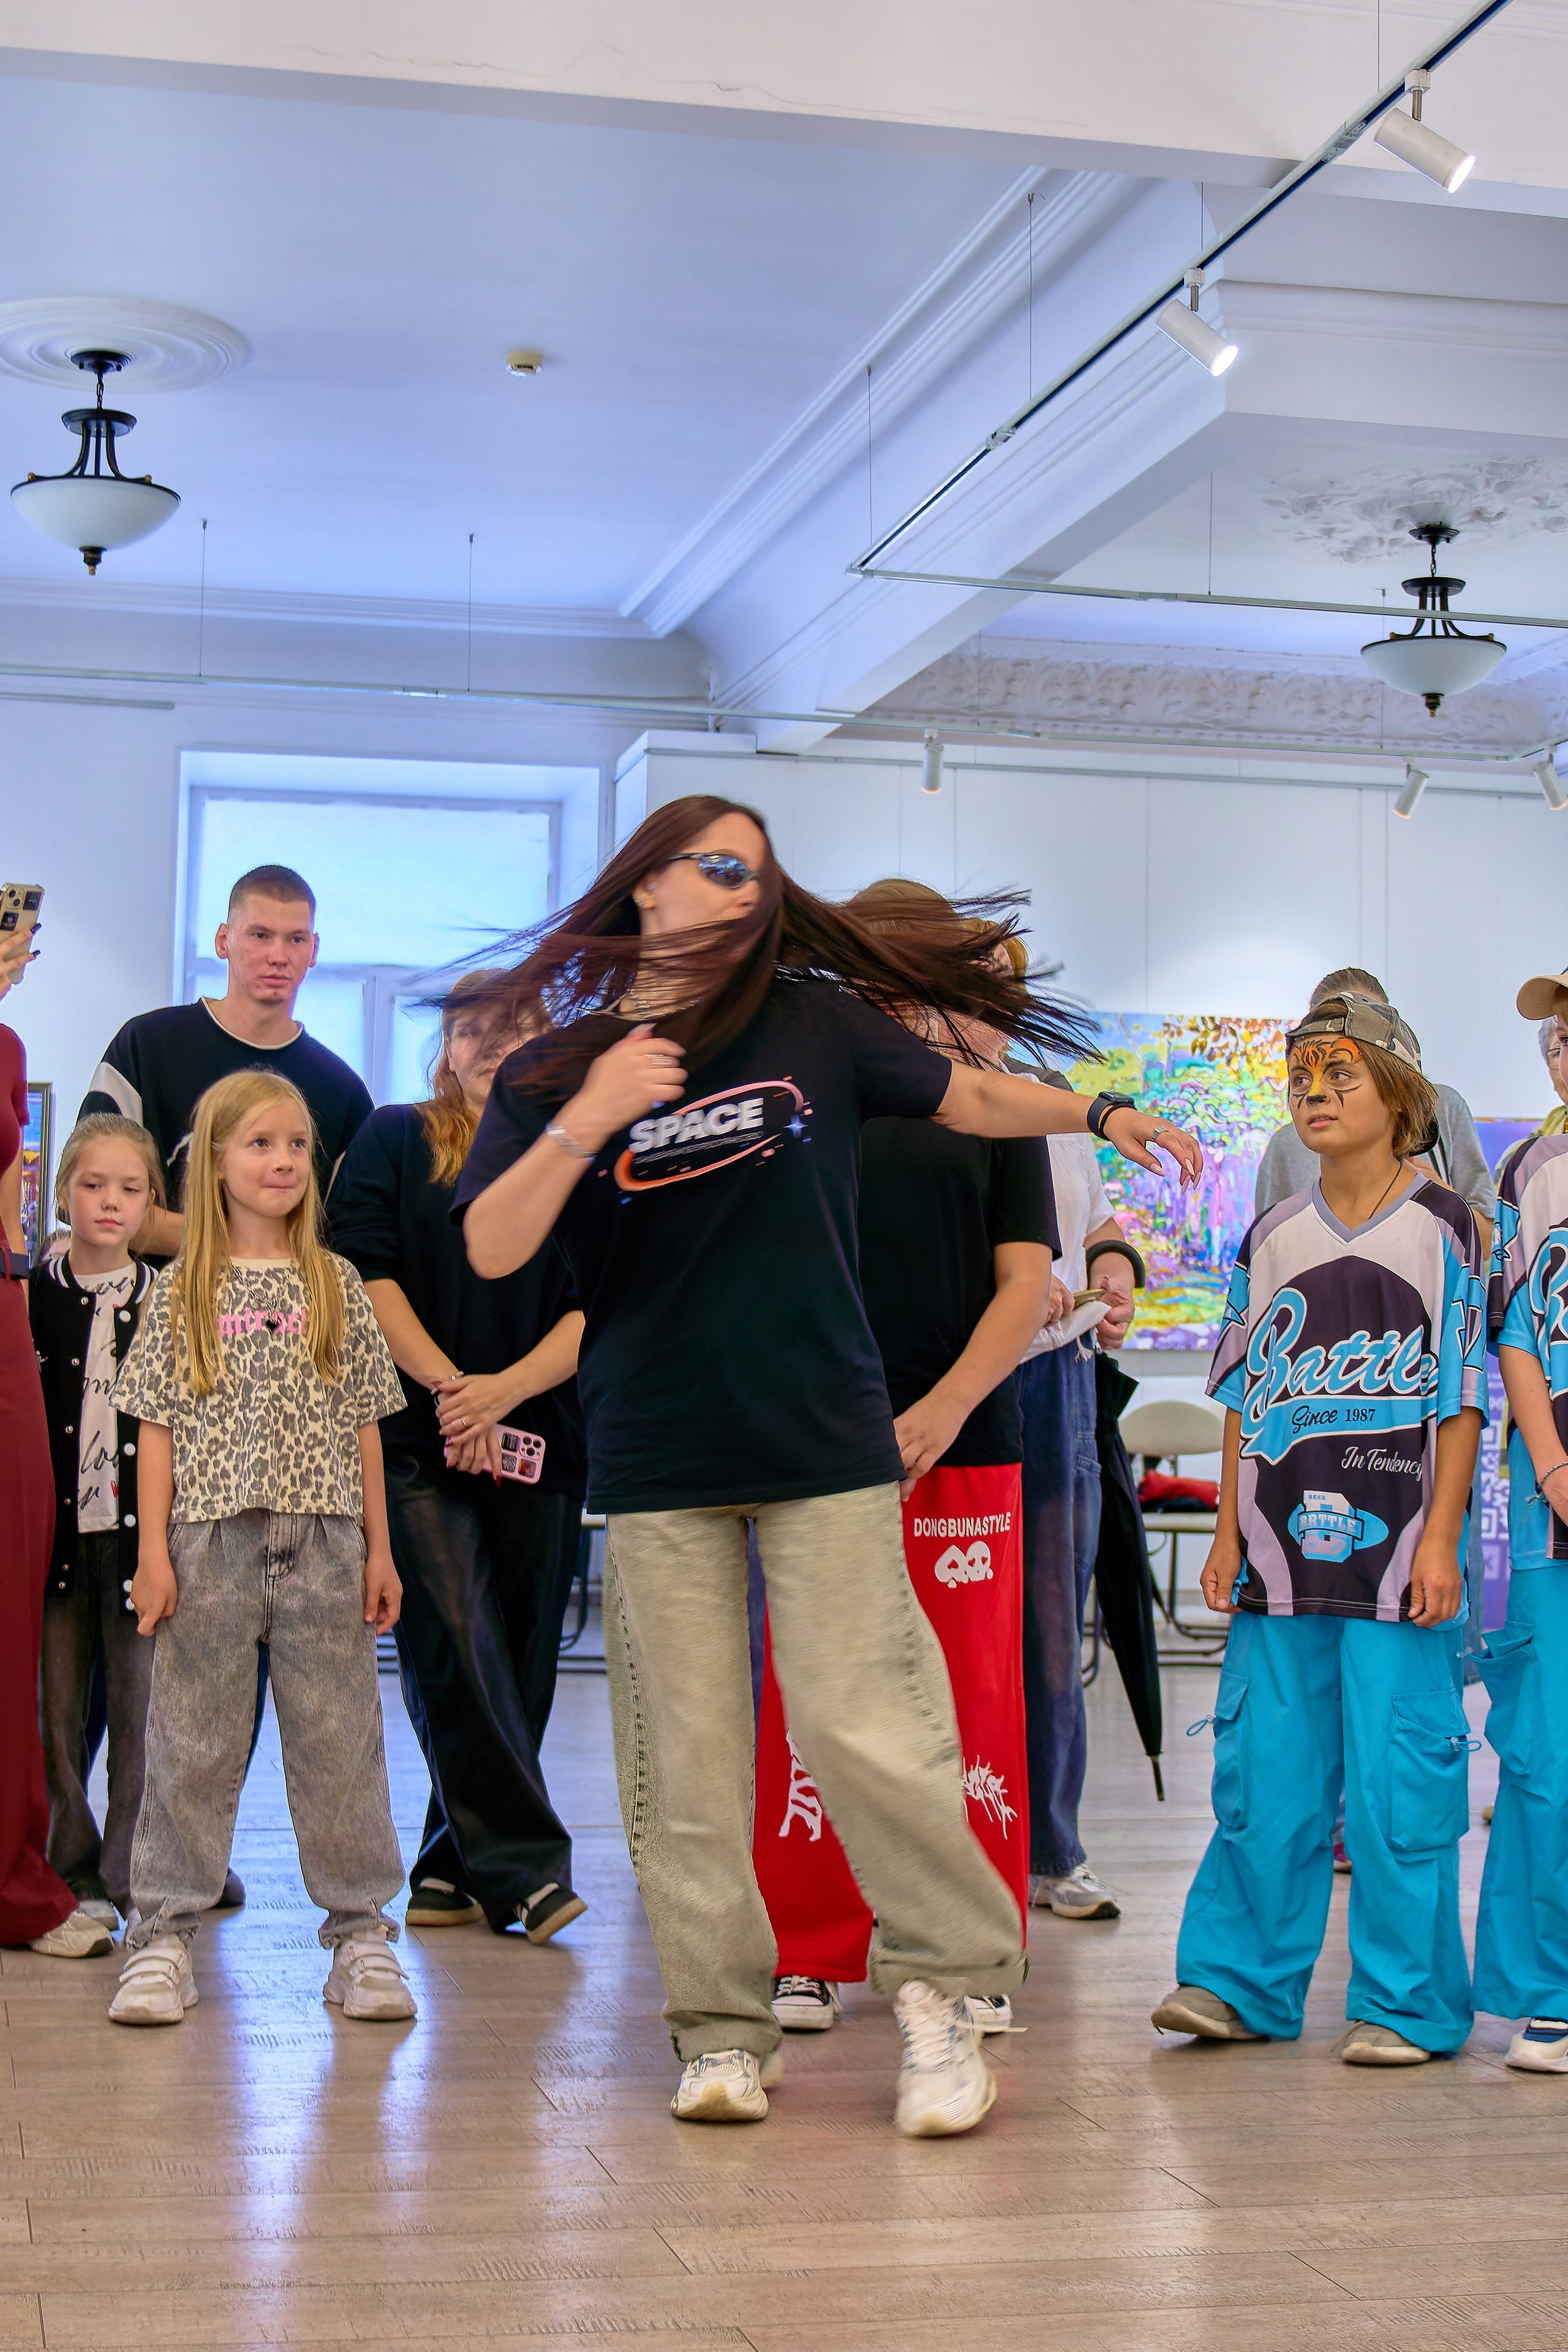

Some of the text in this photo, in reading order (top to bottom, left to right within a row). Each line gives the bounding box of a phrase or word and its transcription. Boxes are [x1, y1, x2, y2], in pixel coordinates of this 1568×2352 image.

[628, 1098, 764, 1154] SPACE
[1292, 1405, 1376, 1434] Since 1987
[1341, 1446, 1422, 1482] In Tendency
[914, 1512, 1011, 1538] DONGBUNASTYLE
